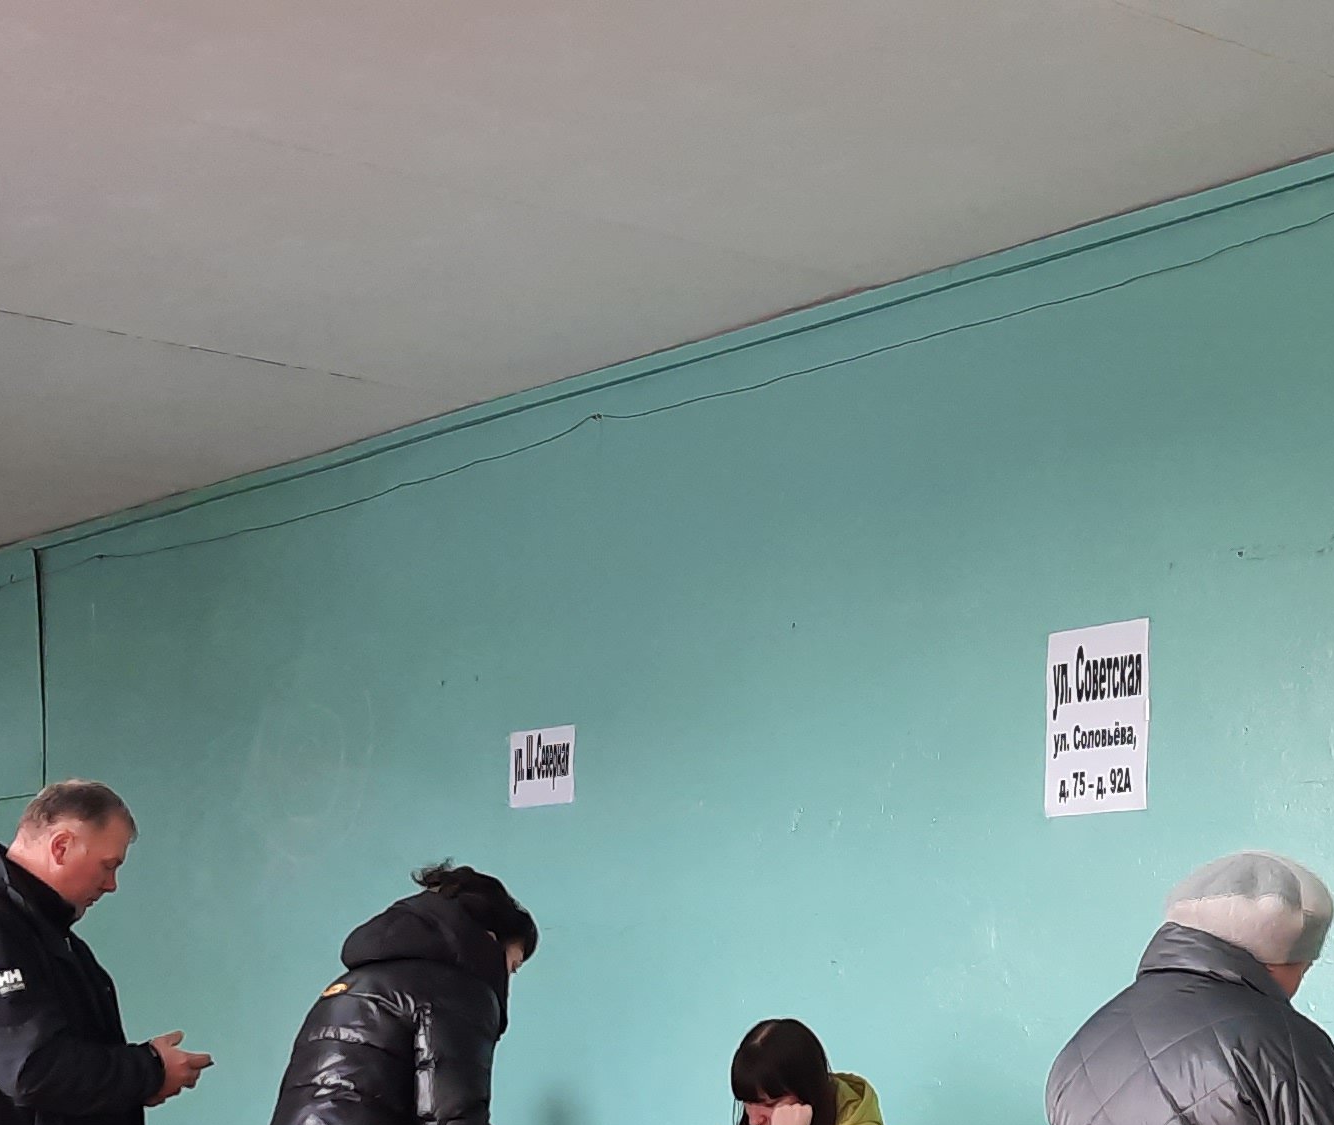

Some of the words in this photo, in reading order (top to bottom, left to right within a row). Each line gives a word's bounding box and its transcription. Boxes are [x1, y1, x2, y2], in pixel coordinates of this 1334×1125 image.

[1053, 662, 1071, 721] ул.
[1076, 645, 1142, 703] Советская
[1053, 732, 1070, 759] ул.
[1073, 721, 1137, 750] Соловьёва,
[514, 748, 524, 795] ул.
[1059, 779, 1069, 804] д.
[1072, 771, 1086, 798] 75
[1096, 776, 1106, 800] д.
[1109, 767, 1132, 795] 92А
